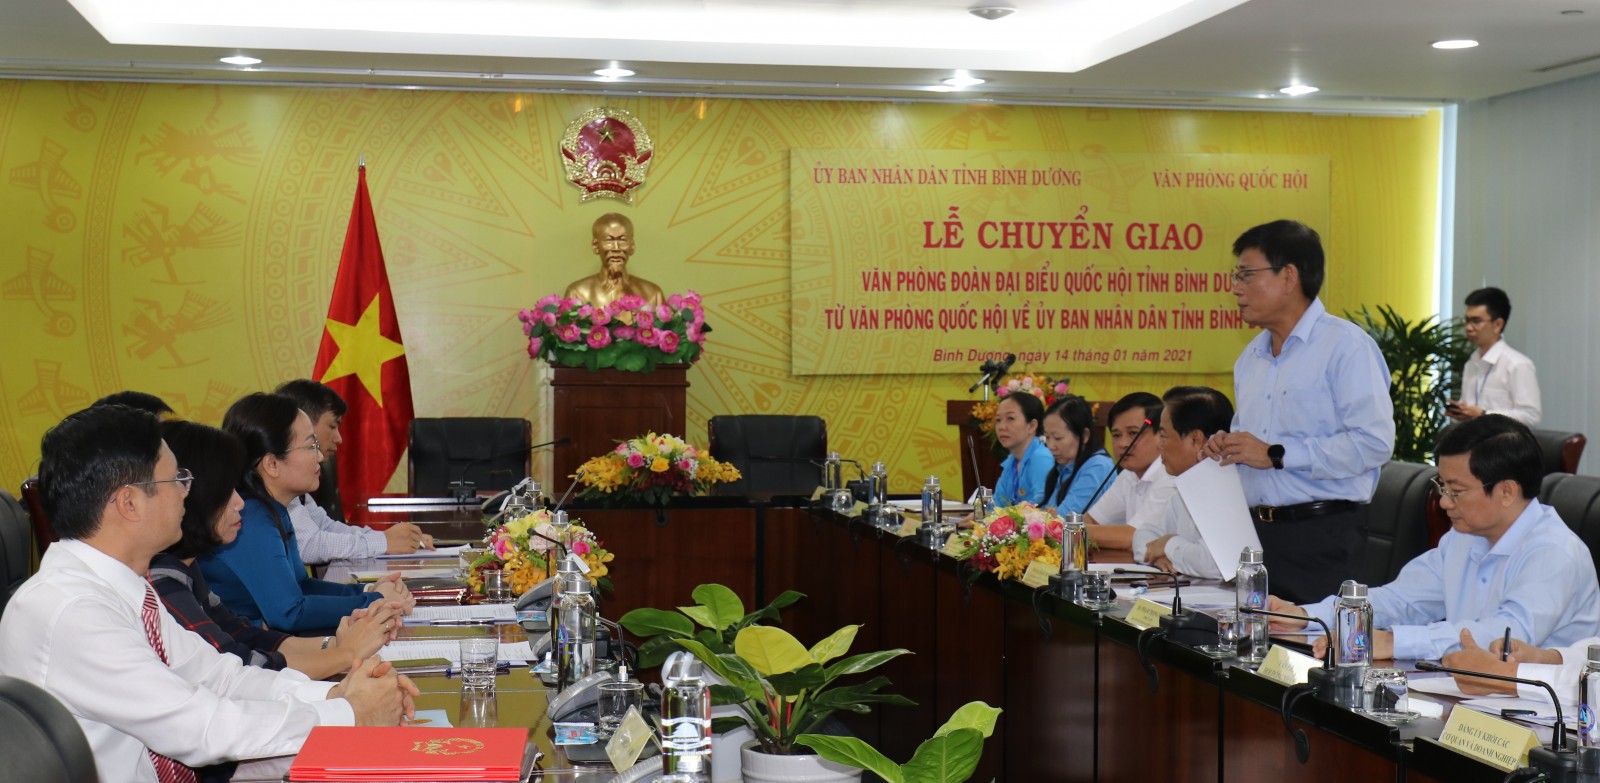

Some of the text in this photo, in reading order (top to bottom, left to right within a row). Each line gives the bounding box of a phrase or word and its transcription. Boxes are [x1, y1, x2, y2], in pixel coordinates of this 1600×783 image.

[813, 161, 1081, 186] ỦY BAN NHÂN DÂN TỈNH BÌNH DƯƠNG
[1153, 166, 1308, 192] VĂN PHÒNG QUỐC HỘI
[923, 205, 1203, 250] LỄ CHUYỂN GIAO
[862, 267, 891, 292] VĂN
[897, 266, 946, 292] PHÒNG
[951, 266, 991, 292] ĐOÀN
[996, 271, 1020, 296] ĐẠI
[1025, 261, 1059, 292] BIỂU
[1064, 264, 1102, 295] QUỐC
[1107, 266, 1132, 296] HỘI
[1137, 265, 1169, 293] TỈNH
[1175, 268, 1208, 293] BÌNH
[825, 300, 1243, 333] TỪ VĂN PHÒNG QUỐC HỘI VỀ ỦY BAN NHÂN DÂN TỈNH BÌNH
[933, 349, 963, 361] Bình
[1018, 349, 1050, 365] ngày
[1056, 349, 1069, 361] 14
[1073, 348, 1110, 364] tháng
[1113, 349, 1127, 361] 01
[1132, 349, 1160, 361] năm
[1163, 349, 1192, 362] 2021
